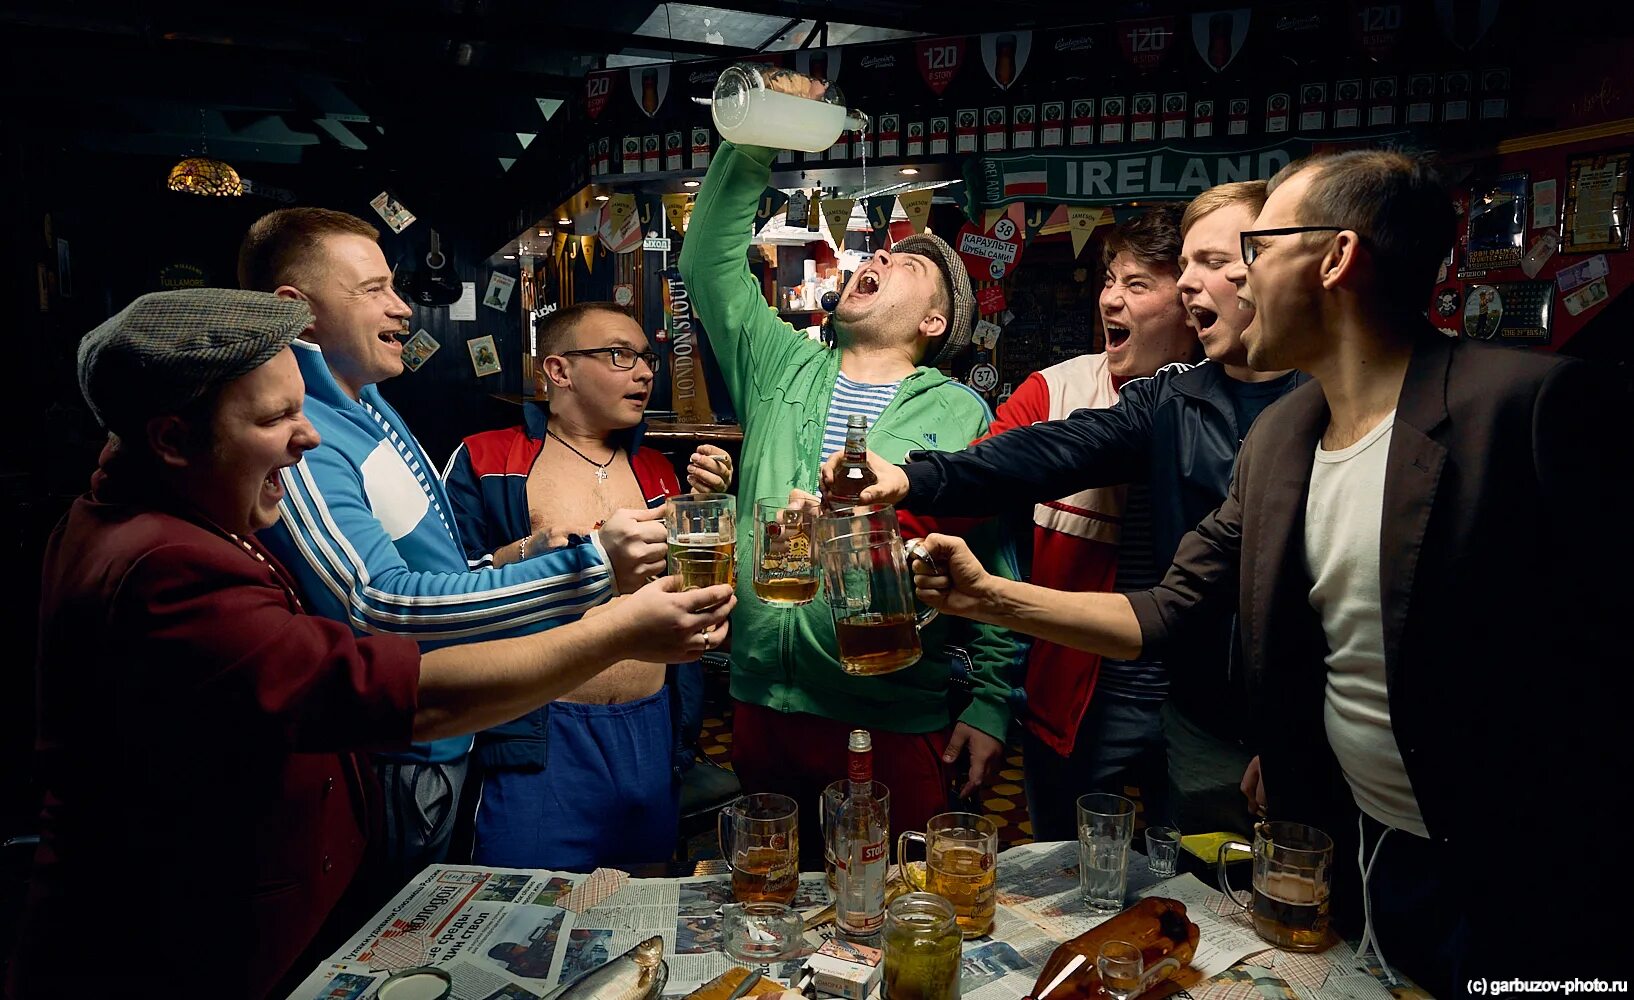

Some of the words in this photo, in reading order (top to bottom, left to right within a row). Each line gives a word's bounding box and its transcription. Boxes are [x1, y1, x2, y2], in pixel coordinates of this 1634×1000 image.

[1127, 26, 1165, 52] 120
[924, 46, 957, 69] 120
[584, 77, 610, 97] 120
[984, 160, 999, 202] IRELAND
[1065, 148, 1291, 196] IRELAND
[826, 208, 849, 216] JAMESON
[905, 201, 929, 210] JAMESON
[1072, 213, 1096, 222] JAMESON
[997, 221, 1013, 237] 38
[643, 239, 668, 249] ЫХОД
[962, 244, 987, 256] ШУБЫ
[964, 233, 1015, 253] КАРАУЛЬТЕ
[160, 279, 206, 288] TULLAMORE
[668, 277, 691, 330] STOUT
[673, 332, 696, 400] LONDON
[976, 370, 991, 382] 37
[437, 941, 465, 966] дин
[460, 912, 490, 939] ствол
[438, 914, 471, 945] среды
[341, 936, 371, 960] Туляки
